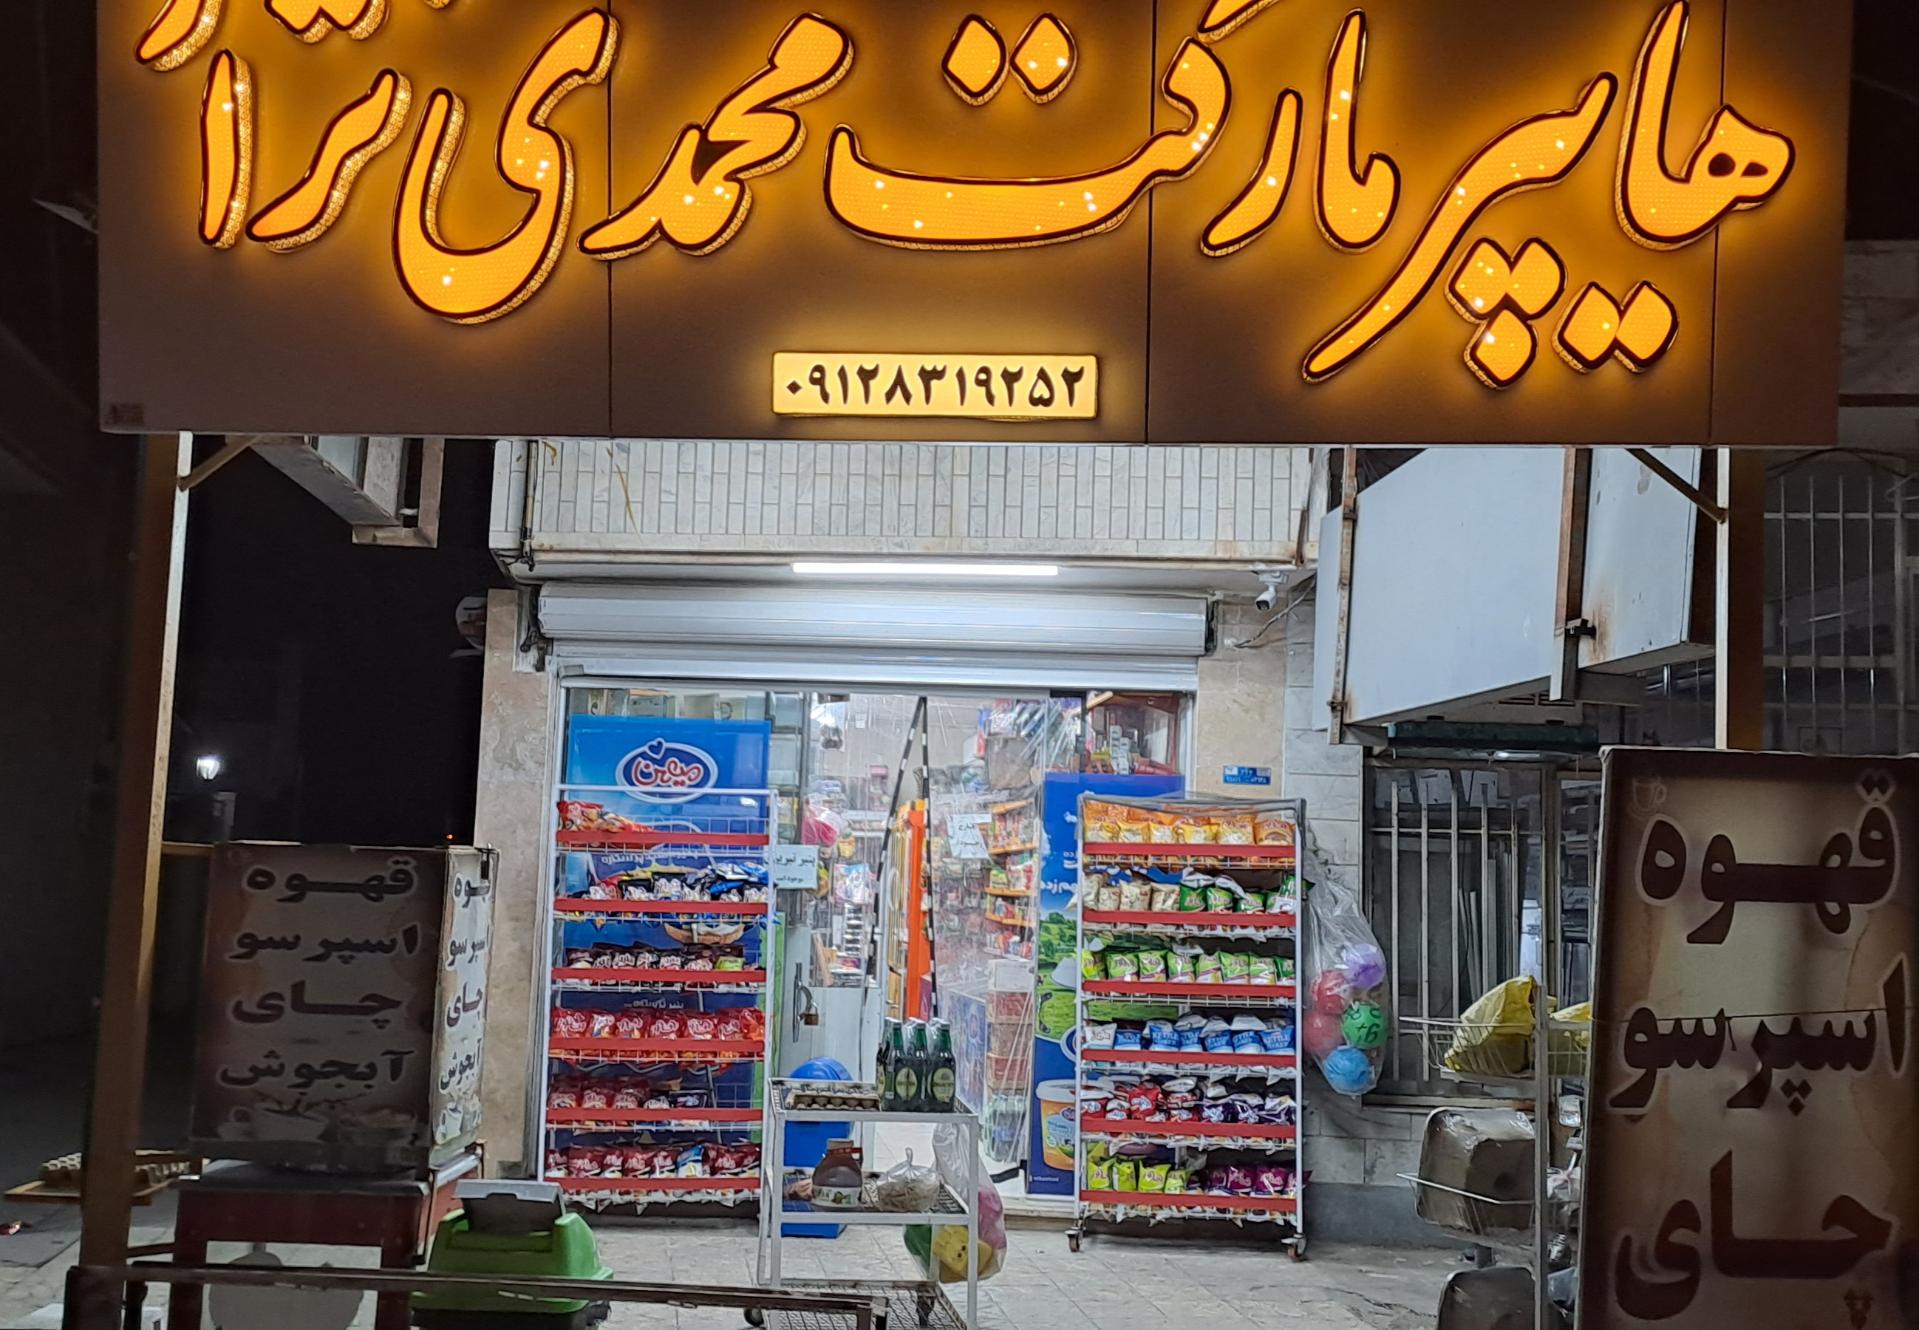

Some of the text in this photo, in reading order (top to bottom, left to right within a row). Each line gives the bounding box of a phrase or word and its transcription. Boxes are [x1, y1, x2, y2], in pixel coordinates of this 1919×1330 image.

[392, 7, 854, 325] محمدی
[1303, 0, 1797, 389] هایپر
[785, 362, 1087, 409] ۰۹۱۲۸۳۱۹۲۵۲
[245, 857, 416, 902] قهوه
[1640, 768, 1898, 945] قهوه
[228, 923, 420, 965] اسپرسو
[231, 980, 403, 1030] چای
[1608, 957, 1907, 1117] اسپرسو
[218, 1049, 415, 1096] آبجوش
[1614, 1148, 1894, 1329] چای
